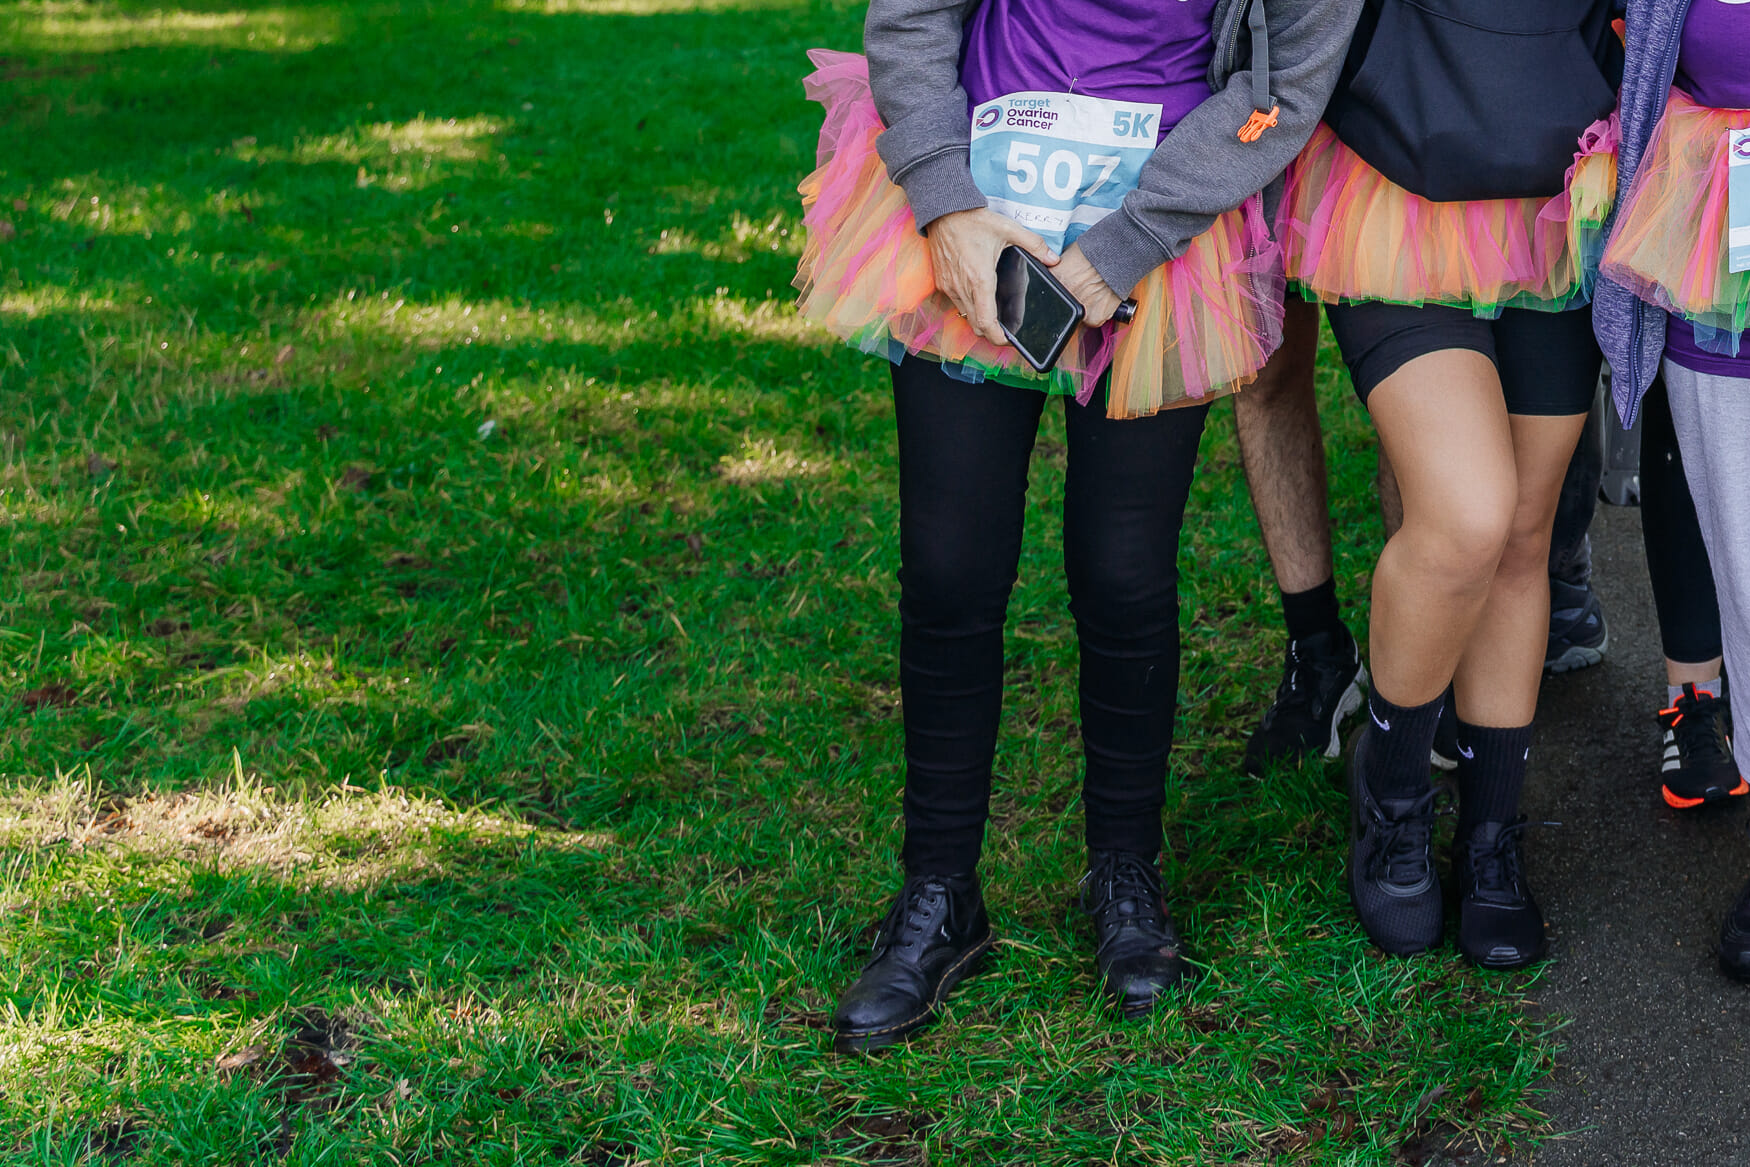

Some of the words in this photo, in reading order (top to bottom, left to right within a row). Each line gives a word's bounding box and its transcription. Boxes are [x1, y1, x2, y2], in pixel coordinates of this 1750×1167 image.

[1007, 98, 1051, 110] Target
[1007, 107, 1059, 121] Ovarian
[1006, 117, 1054, 130] Cancer
[1112, 110, 1155, 138] 5K
[1006, 140, 1121, 201] 507
